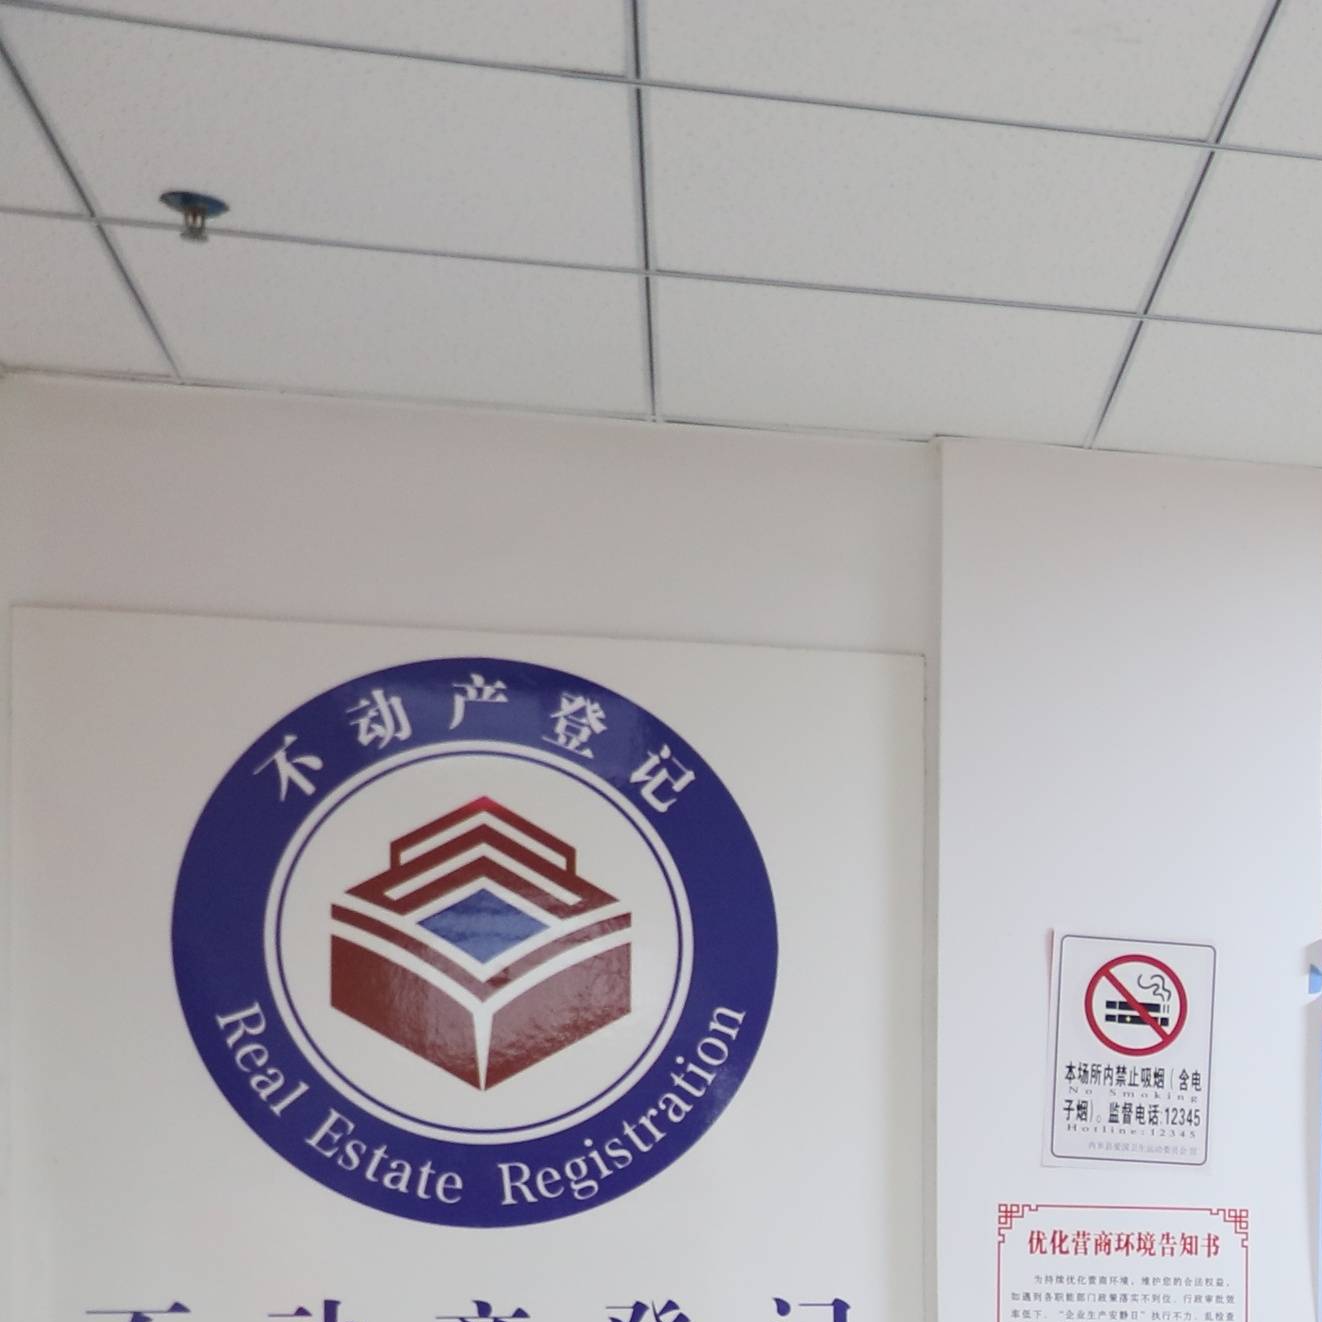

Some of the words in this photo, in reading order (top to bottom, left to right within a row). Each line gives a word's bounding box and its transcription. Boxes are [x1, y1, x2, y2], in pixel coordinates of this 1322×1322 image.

[255, 673, 697, 815] 不动产登记
[215, 1000, 306, 1121] Real
[304, 1117, 467, 1207] Estate
[497, 1001, 748, 1207] Registration
[1064, 1061, 1202, 1092] 本场所内禁止吸烟（含电
[1028, 1230, 1220, 1258] 优化营商环境告知书
